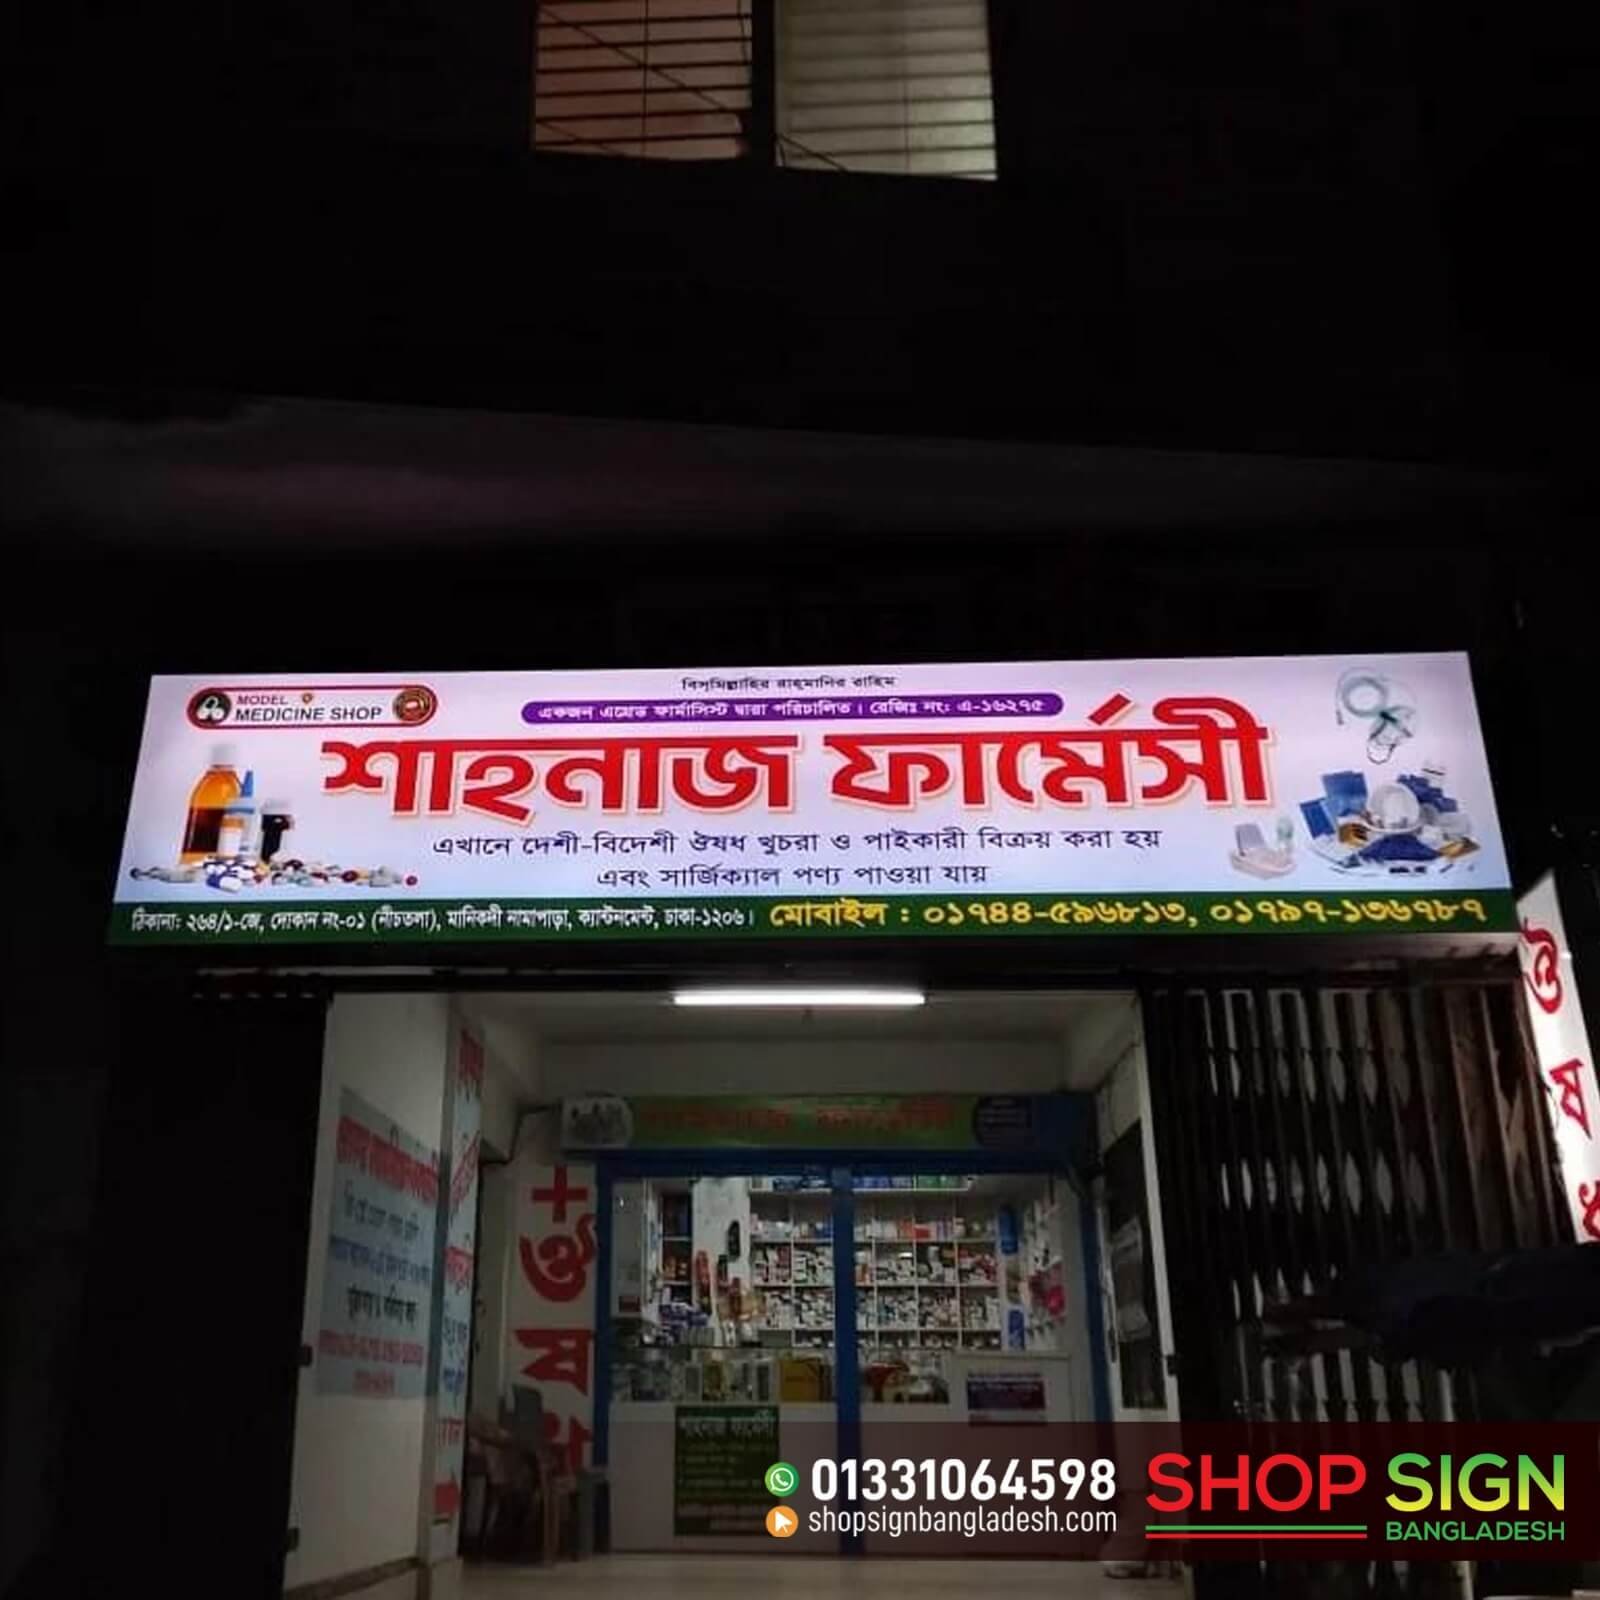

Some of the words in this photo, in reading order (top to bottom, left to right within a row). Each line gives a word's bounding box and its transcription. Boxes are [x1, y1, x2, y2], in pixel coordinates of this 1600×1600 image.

[236, 695, 289, 705] MODEL
[538, 705, 593, 720] একজন
[772, 699, 850, 716] পরিচালিত
[235, 706, 325, 722] MEDICINE
[330, 706, 382, 721] SHOP
[320, 733, 799, 822] শাহনাজ
[823, 692, 1270, 808] ফার্মেসী
[433, 835, 510, 855] এখানে
[522, 829, 675, 855] দেশী-বিদেশী
[689, 830, 745, 853] ঔষধ
[758, 832, 819, 856] খুচরা
[830, 832, 850, 850] ও
[864, 826, 968, 851] পাইকারী
[978, 826, 1051, 849] বিক্রয়
[1062, 829, 1112, 849] করা
[1122, 828, 1162, 848] হয়
[597, 868, 650, 888] এবং
[660, 864, 781, 888] সার্জিক্যাল
[793, 865, 841, 885] পণ্য
[854, 863, 931, 885] পাওয়া
[941, 863, 990, 884] যায়
[271, 911, 318, 931] দোকান
[322, 911, 365, 931] নং-০১
[770, 898, 887, 927] মোবাইল
[923, 900, 1197, 927] ০১৭৪৪-৫৯৬৮১৩,
